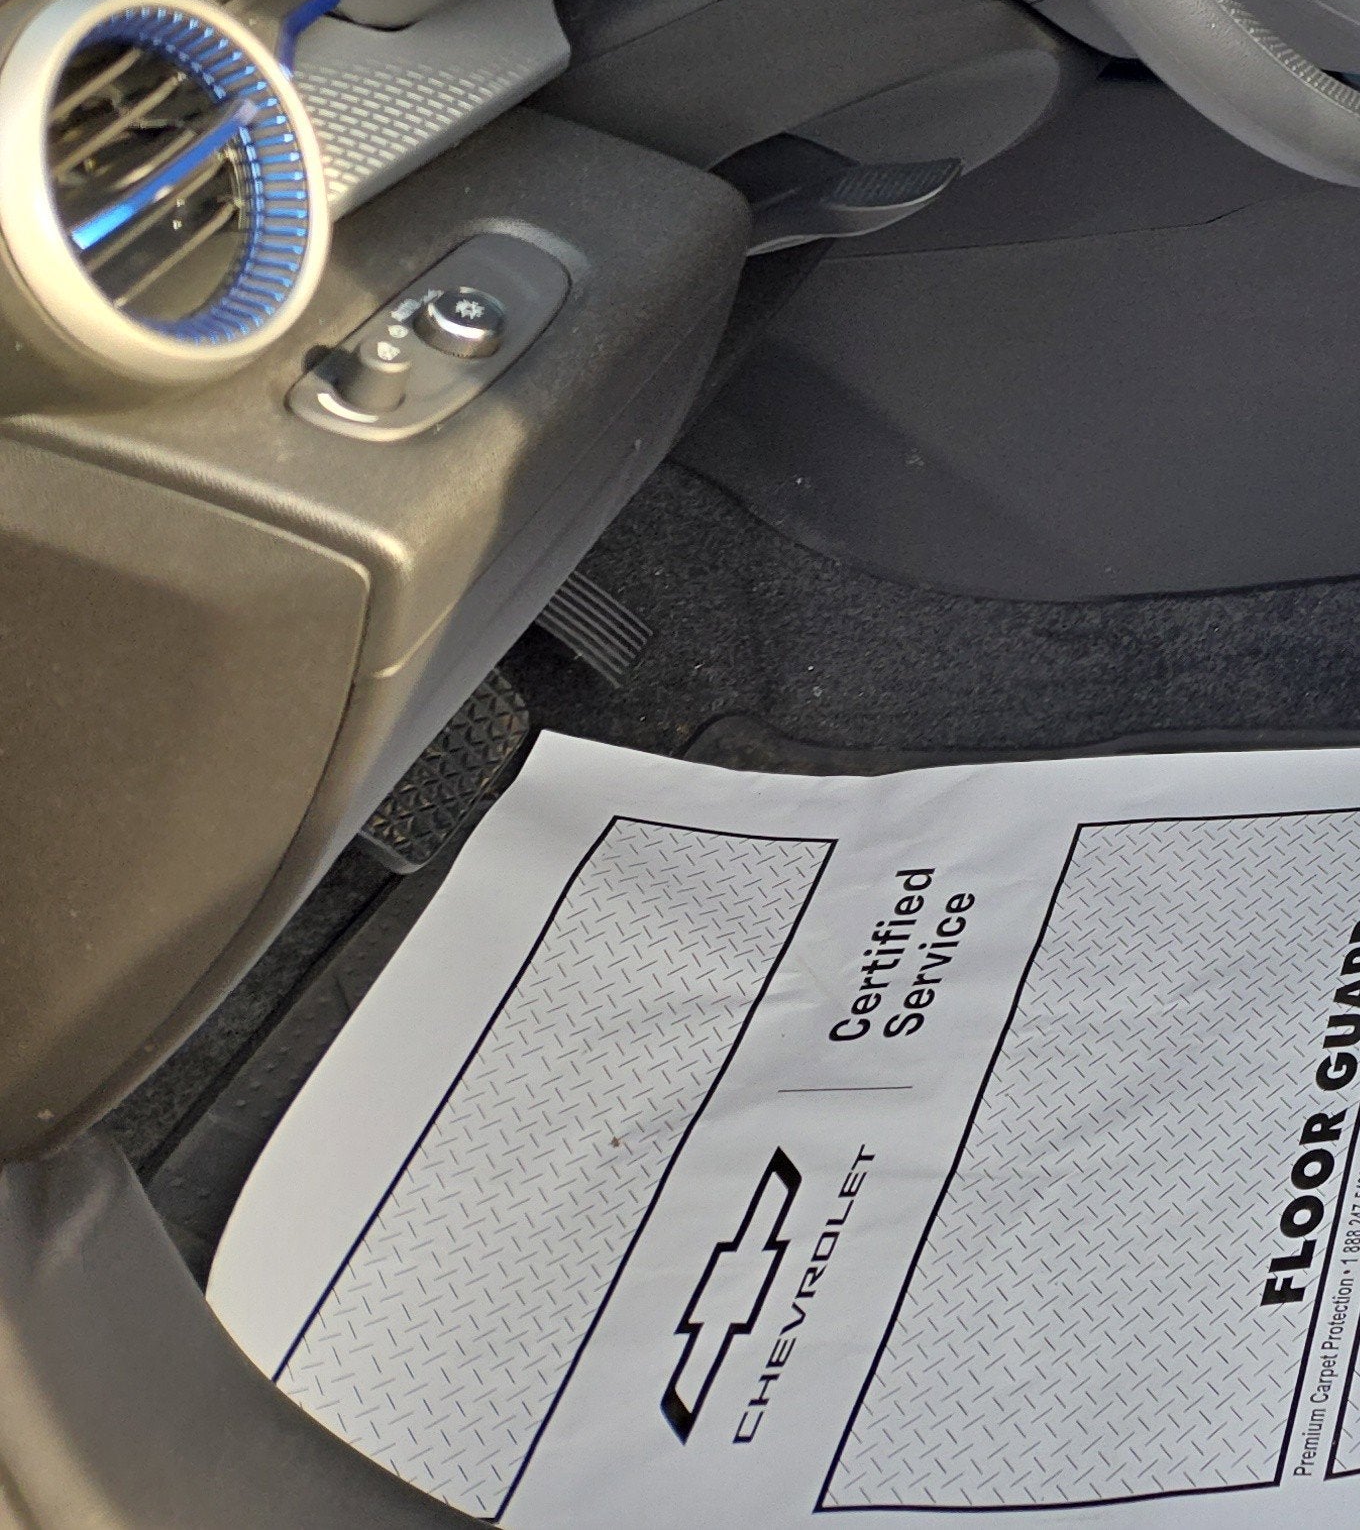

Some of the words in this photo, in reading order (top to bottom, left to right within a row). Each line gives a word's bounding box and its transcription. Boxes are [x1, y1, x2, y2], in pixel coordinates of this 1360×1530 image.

[828, 867, 936, 1042] Certified
[883, 891, 976, 1038] Service
[1260, 1108, 1348, 1307] FLOOR
[1342, 1257, 1358, 1266] 1
[732, 1144, 877, 1444] CHEVROLET
[1321, 1278, 1354, 1351] Protection
[1310, 1352, 1339, 1404] Carpet
[1293, 1408, 1326, 1477] Premium
